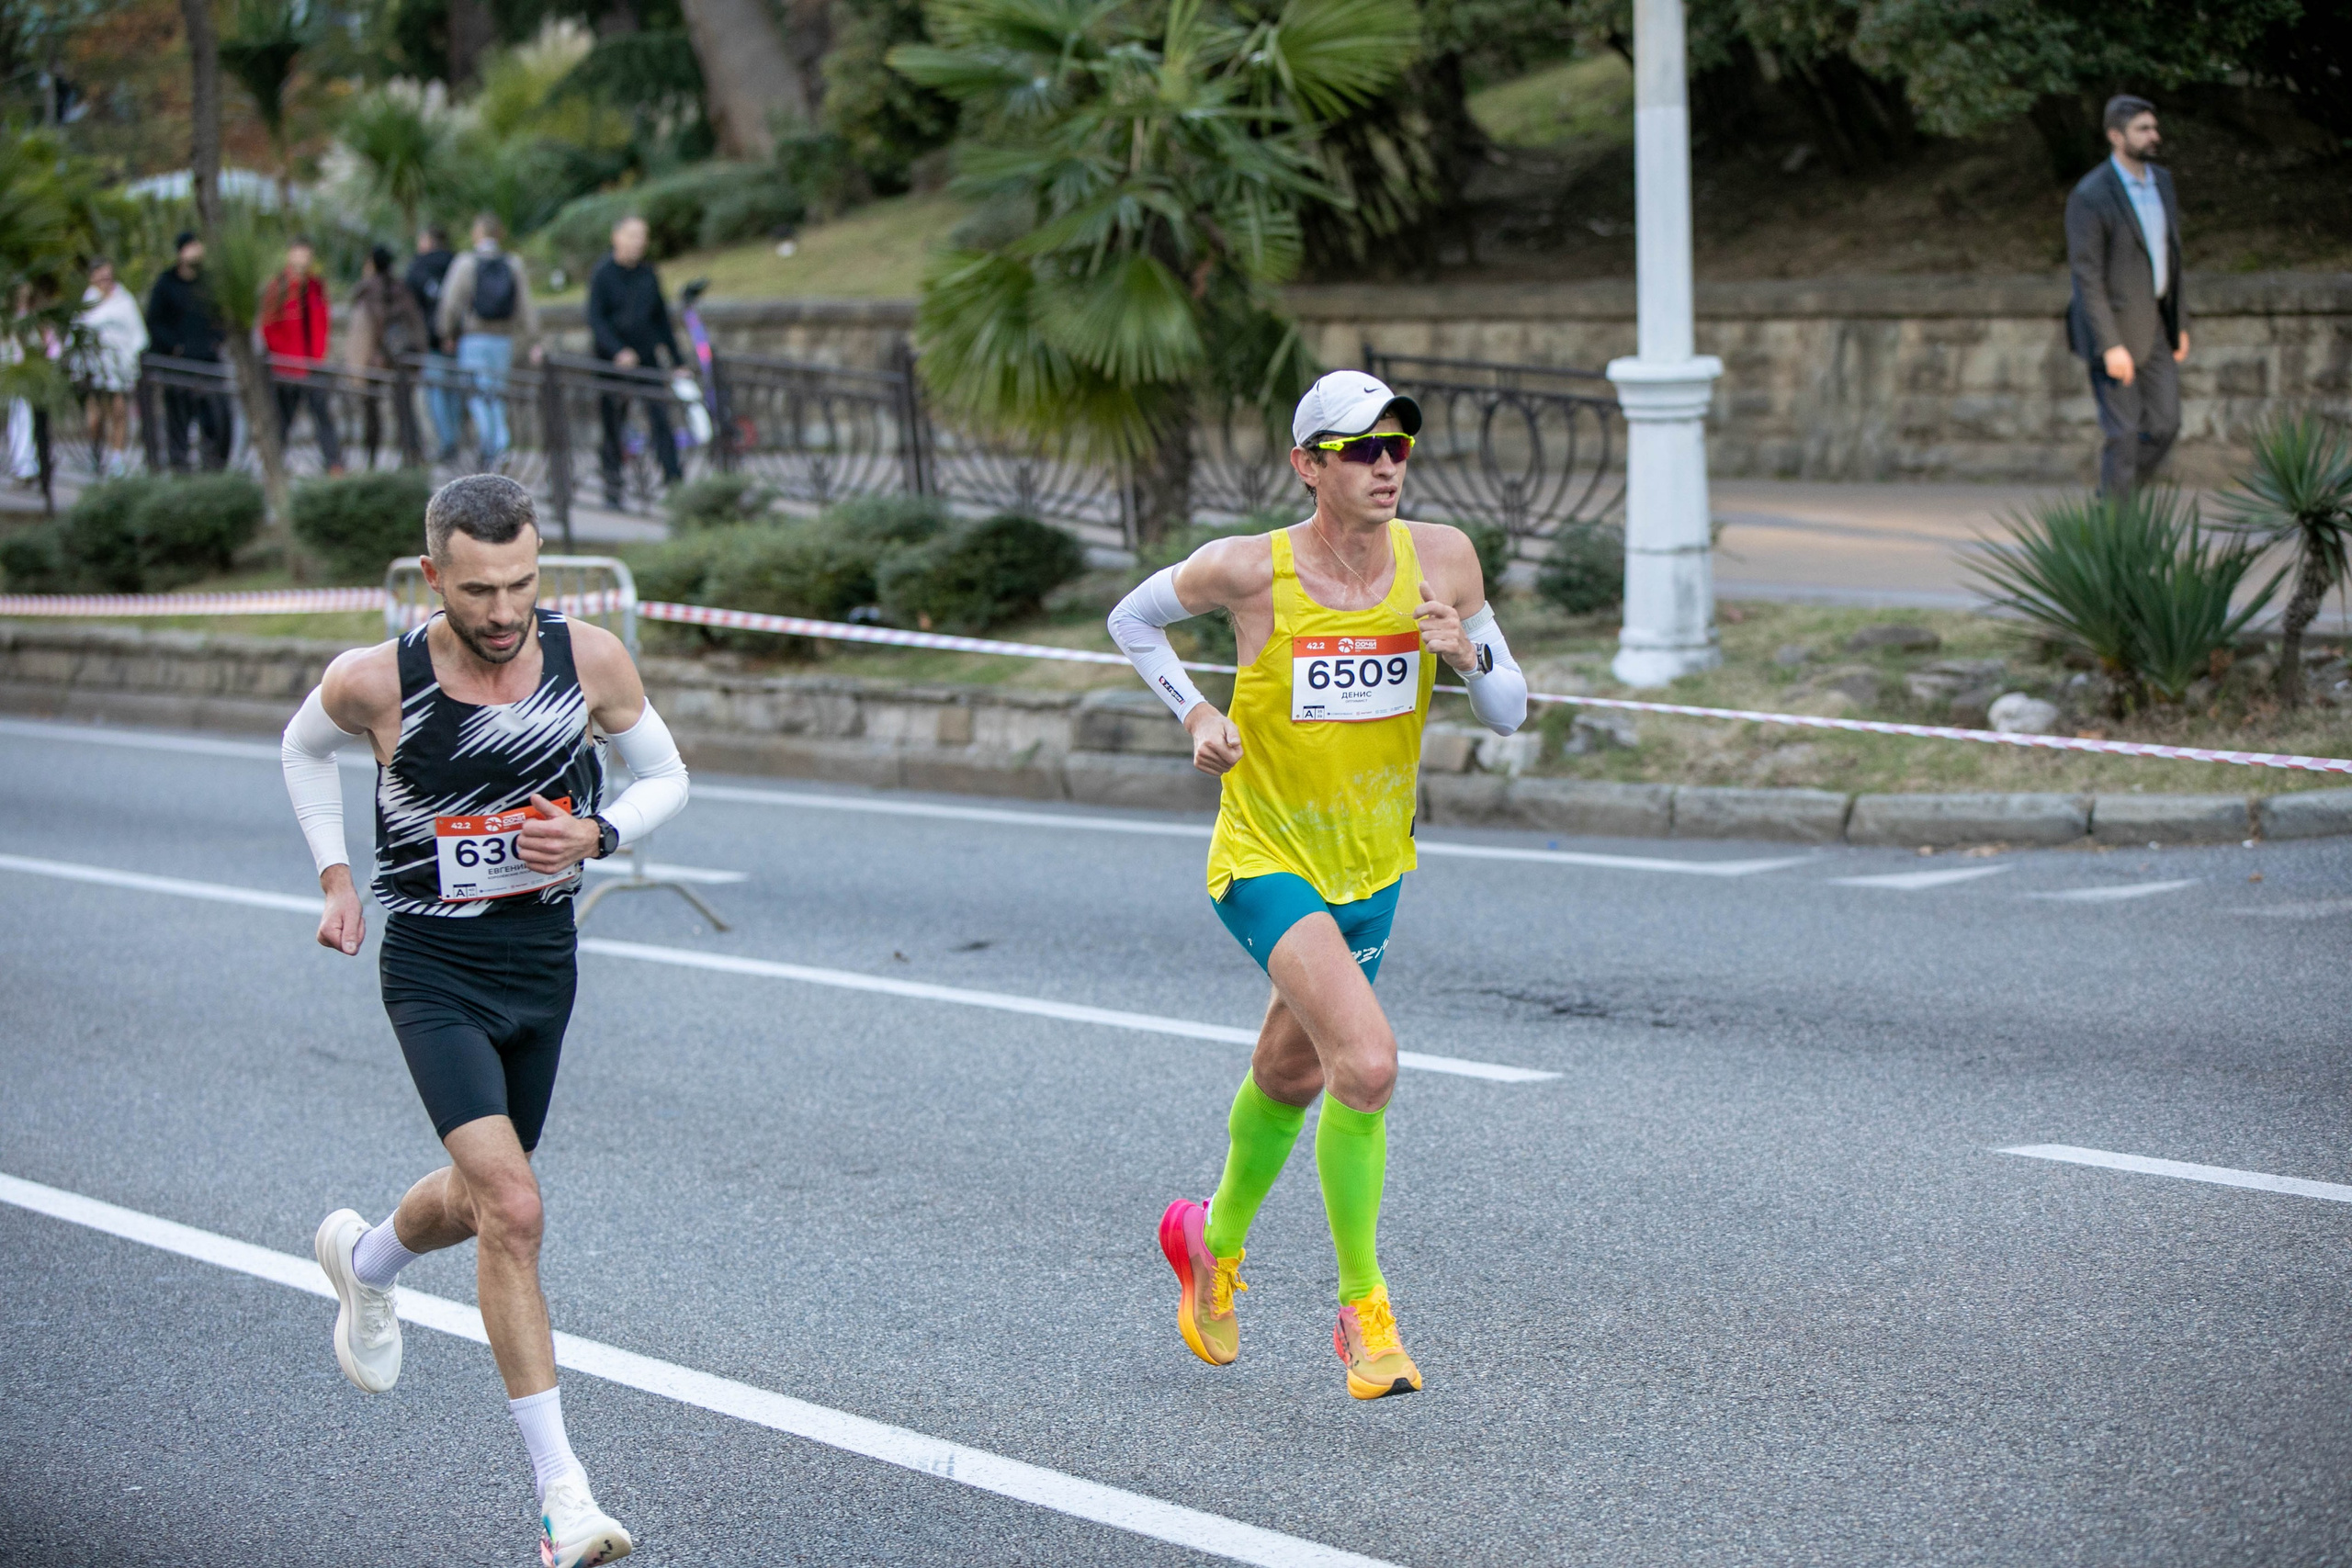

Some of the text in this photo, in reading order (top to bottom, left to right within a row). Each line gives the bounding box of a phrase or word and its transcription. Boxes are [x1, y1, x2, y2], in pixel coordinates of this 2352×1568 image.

[1308, 658, 1408, 690] 6509
[1341, 691, 1372, 700] ДЕНИС
[1305, 710, 1314, 718] A
[456, 834, 520, 867] 63
[456, 888, 466, 897] A
